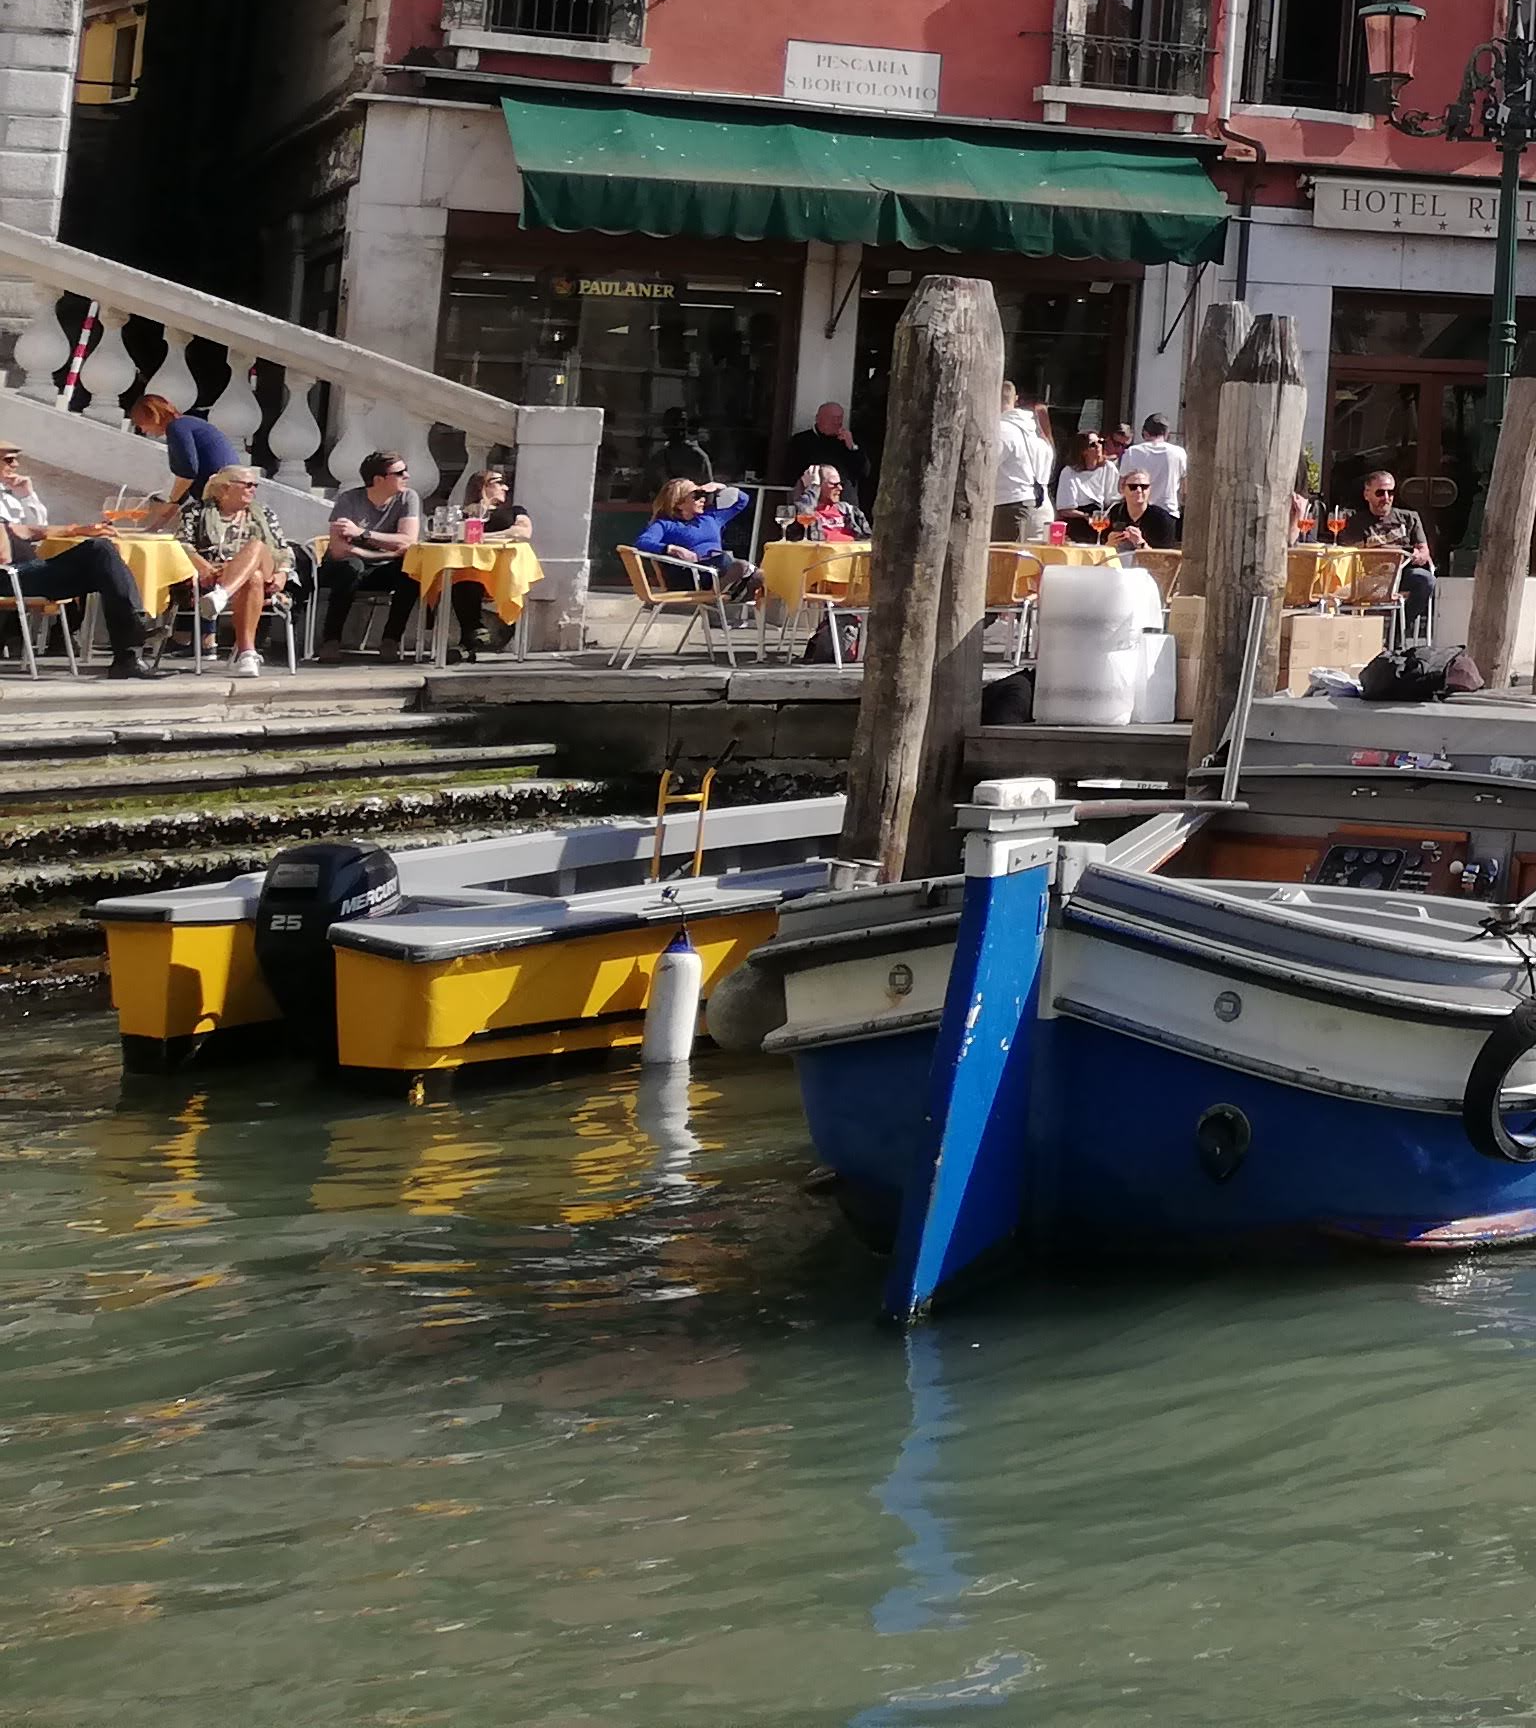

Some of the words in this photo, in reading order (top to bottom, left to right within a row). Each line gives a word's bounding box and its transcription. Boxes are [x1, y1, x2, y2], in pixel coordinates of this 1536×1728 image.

[816, 54, 909, 75] PESCARIA
[802, 76, 937, 101] BORTOLOMIO
[1341, 188, 1447, 217] HOTEL
[578, 279, 675, 298] PAULANER
[270, 914, 303, 931] 25
